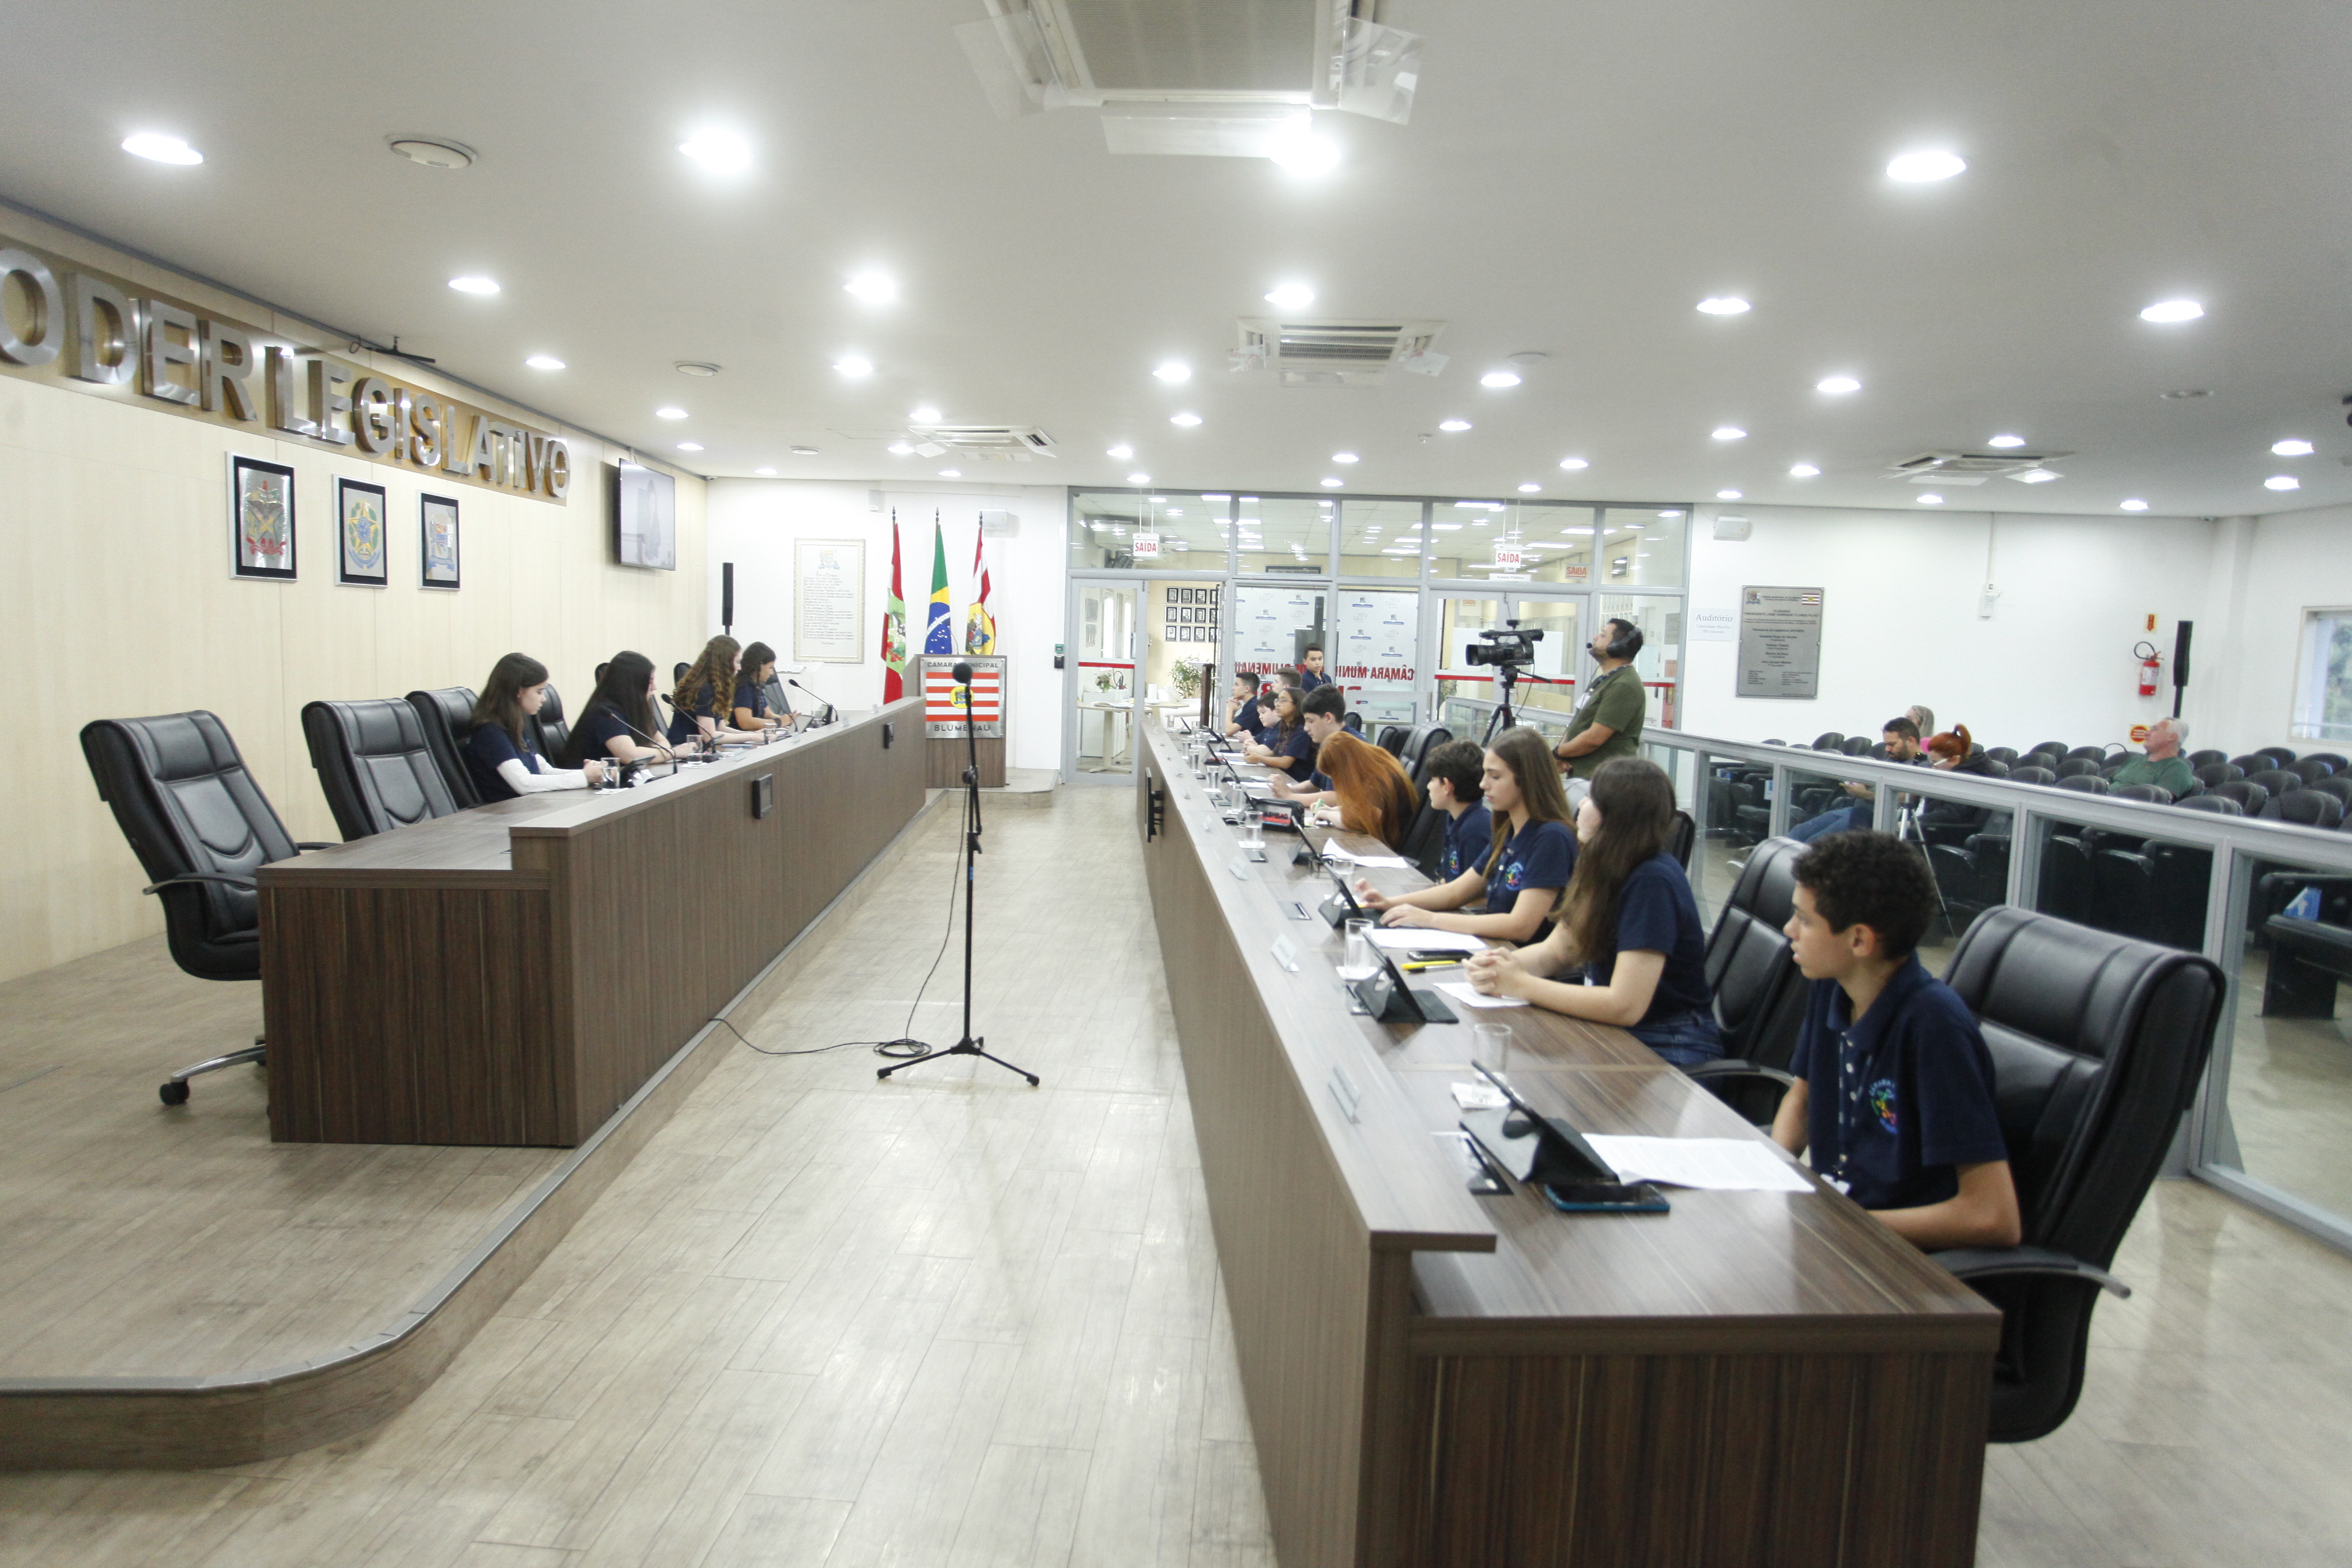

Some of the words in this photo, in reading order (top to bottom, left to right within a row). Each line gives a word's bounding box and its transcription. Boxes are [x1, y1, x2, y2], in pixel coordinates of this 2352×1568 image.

[272, 346, 571, 497] LEGISLATIVO
[1135, 541, 1156, 552] SAÍDA
[1497, 552, 1520, 563] SAÍDA
[1695, 614, 1732, 622] Auditório
